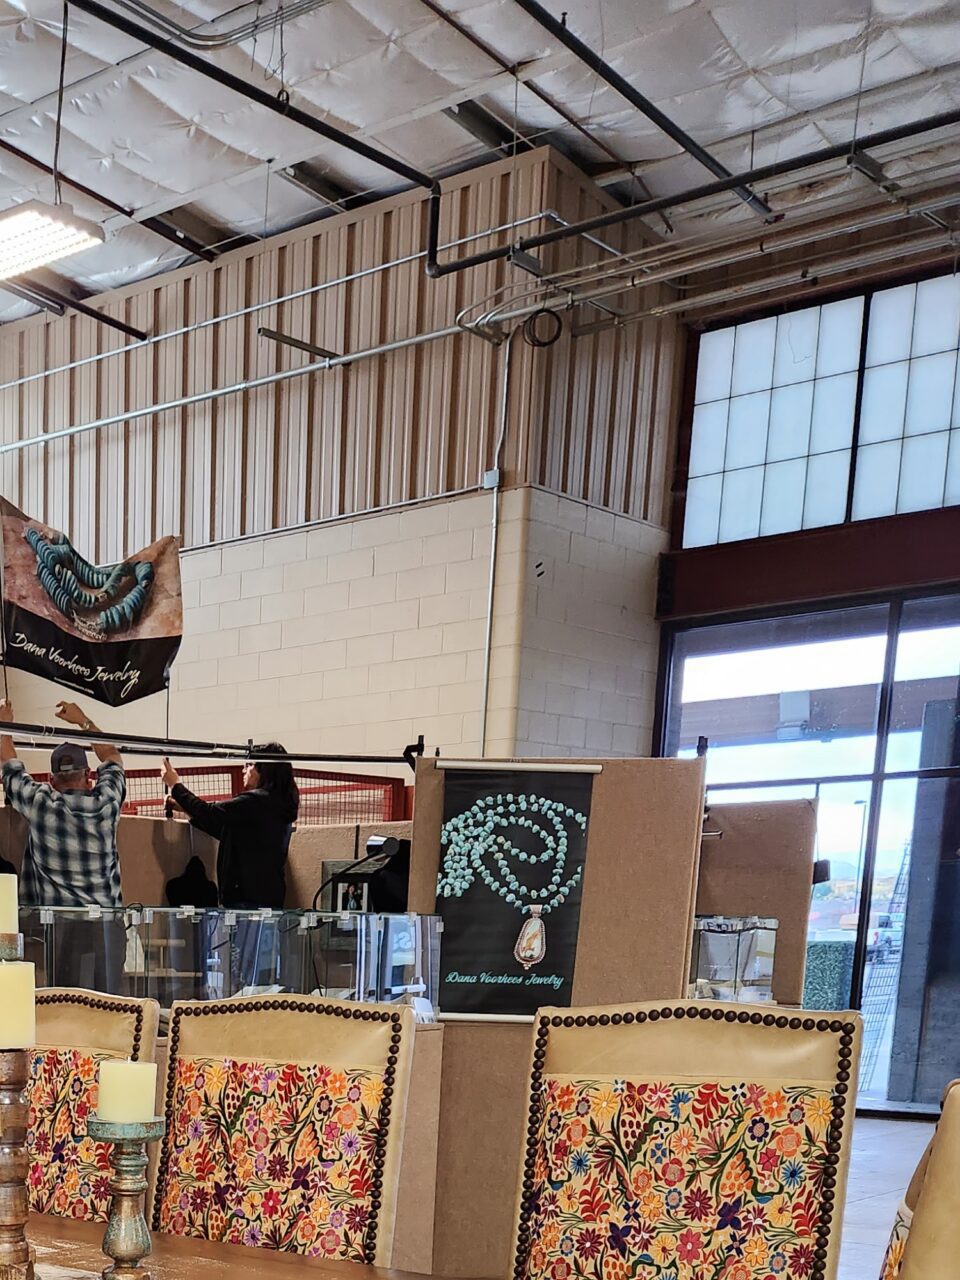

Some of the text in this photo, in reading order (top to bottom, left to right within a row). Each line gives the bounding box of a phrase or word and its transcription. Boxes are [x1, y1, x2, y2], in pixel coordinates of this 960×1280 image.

[10, 632, 46, 656] Dana
[48, 646, 91, 676] Voorhees
[84, 661, 141, 698] Jewelry
[445, 970, 565, 990] Dana Voorhees Jewelry
